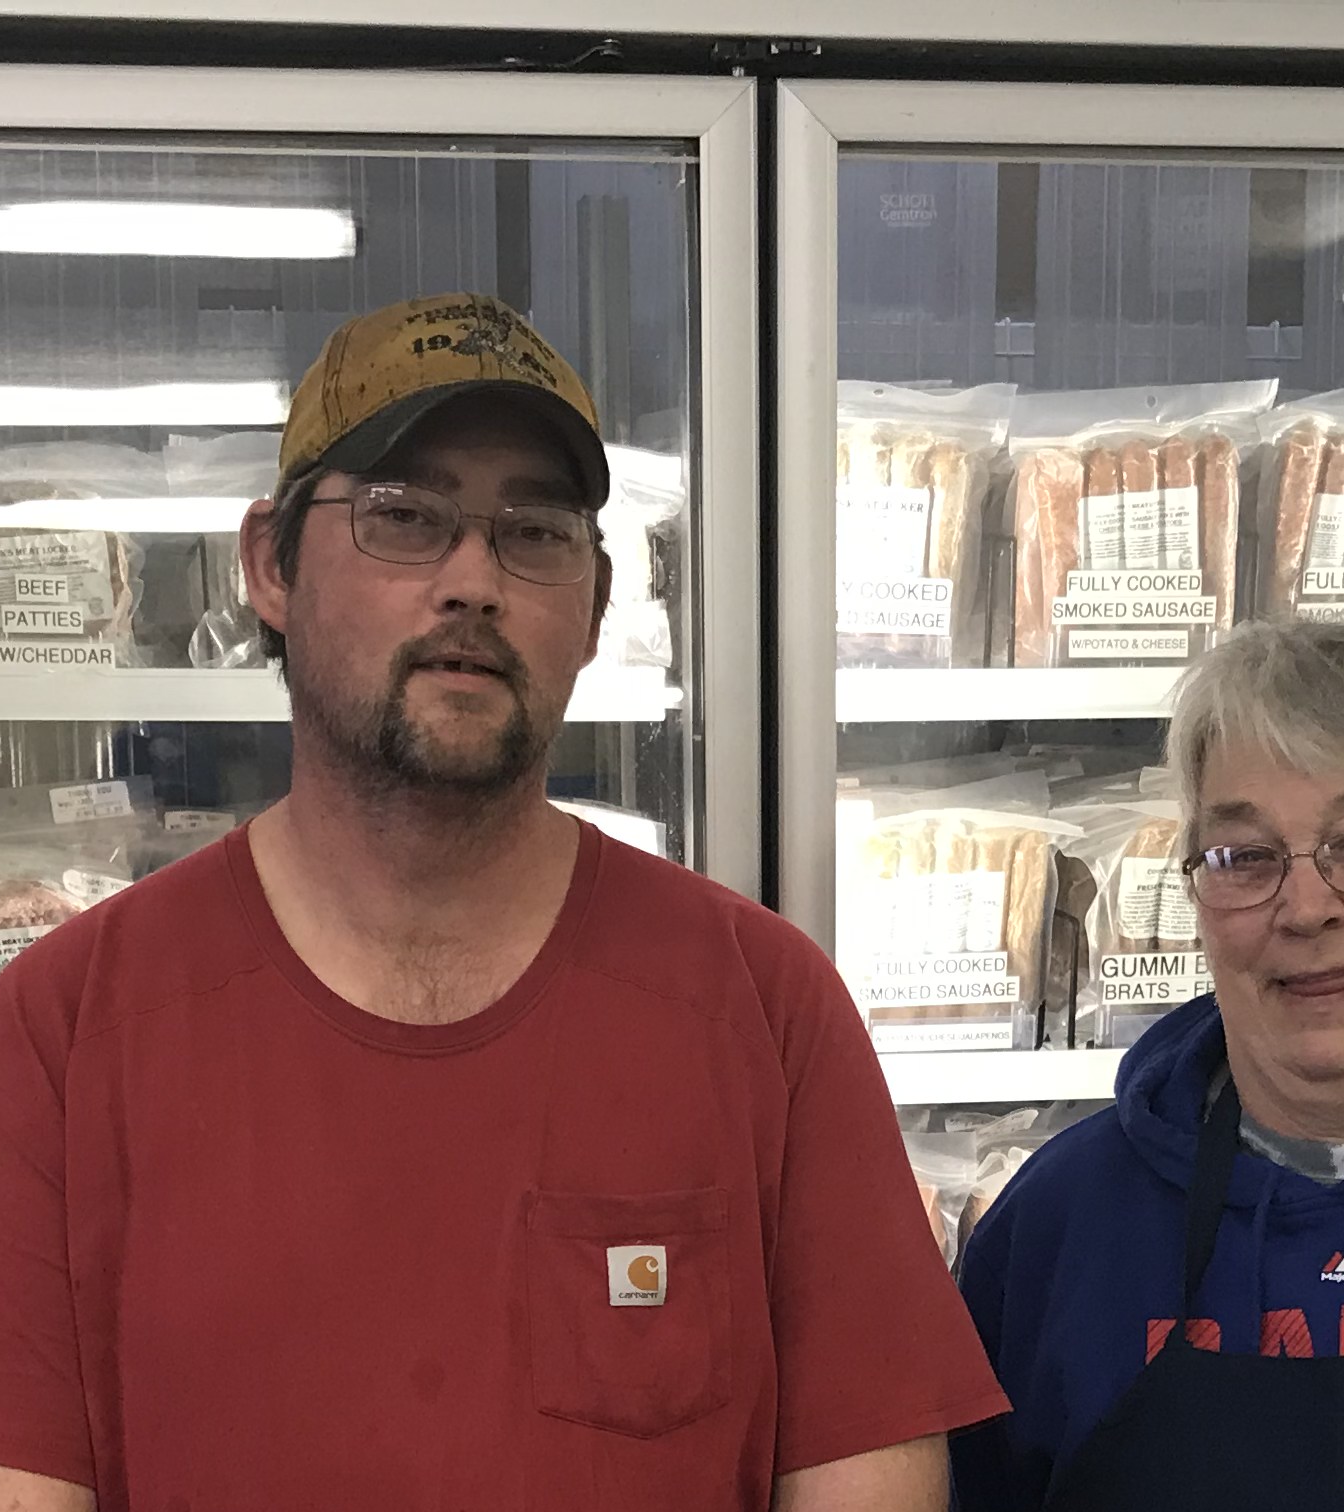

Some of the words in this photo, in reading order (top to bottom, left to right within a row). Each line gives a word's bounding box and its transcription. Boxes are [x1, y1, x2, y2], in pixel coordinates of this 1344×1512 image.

[18, 579, 66, 596] BEEF
[1068, 576, 1122, 592] FULLY
[1126, 575, 1202, 592] COOKED
[860, 584, 948, 602] COOKED
[1053, 603, 1128, 618] SMOKED
[1132, 601, 1215, 618] SAUSAGE
[4, 612, 82, 628] PATTIES
[866, 613, 946, 630] SAUSAGE
[1071, 638, 1130, 650] W/POTATO
[1132, 638, 1140, 650] &
[1141, 638, 1186, 650] CHEESE
[0, 647, 112, 664] W/CHEDDAR
[876, 960, 928, 976] FULLY
[934, 958, 1006, 974] COOKED
[1101, 955, 1186, 978] GUMMI
[936, 982, 1017, 998] SAUSAGE
[1105, 982, 1170, 1000] BRATS
